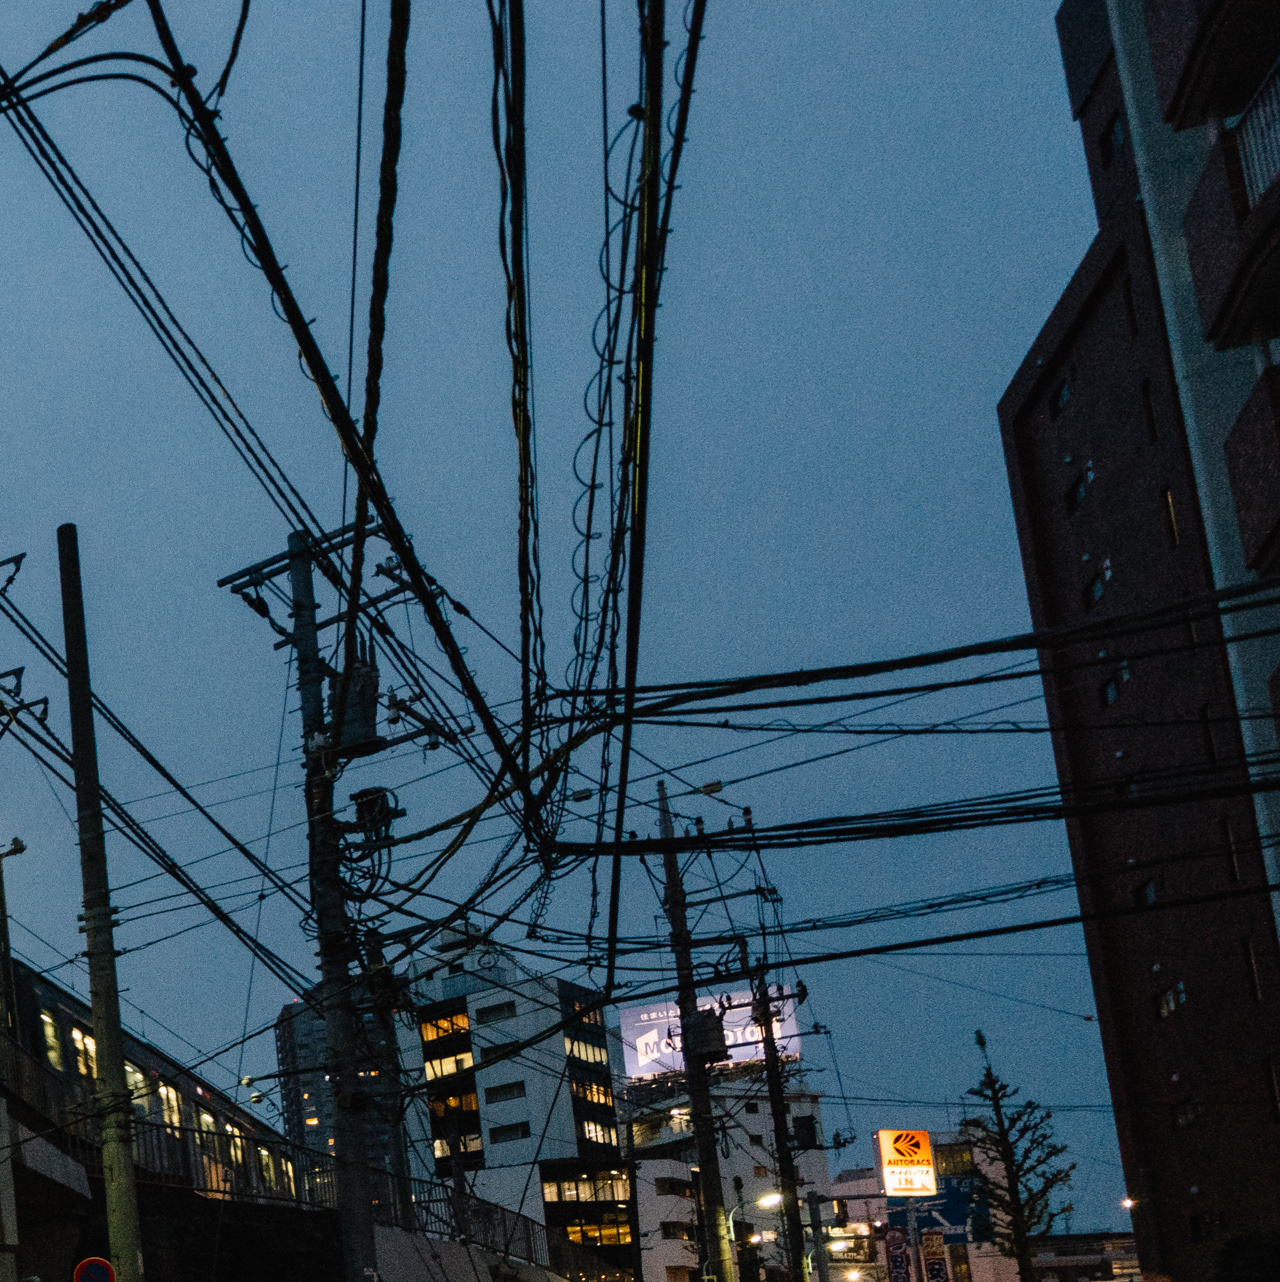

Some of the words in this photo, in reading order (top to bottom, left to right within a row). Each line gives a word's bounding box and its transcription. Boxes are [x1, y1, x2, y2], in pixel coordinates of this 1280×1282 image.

[887, 1159, 931, 1167] AUTOBACS
[889, 1169, 931, 1177] オートバックス
[898, 1178, 914, 1187] IN
